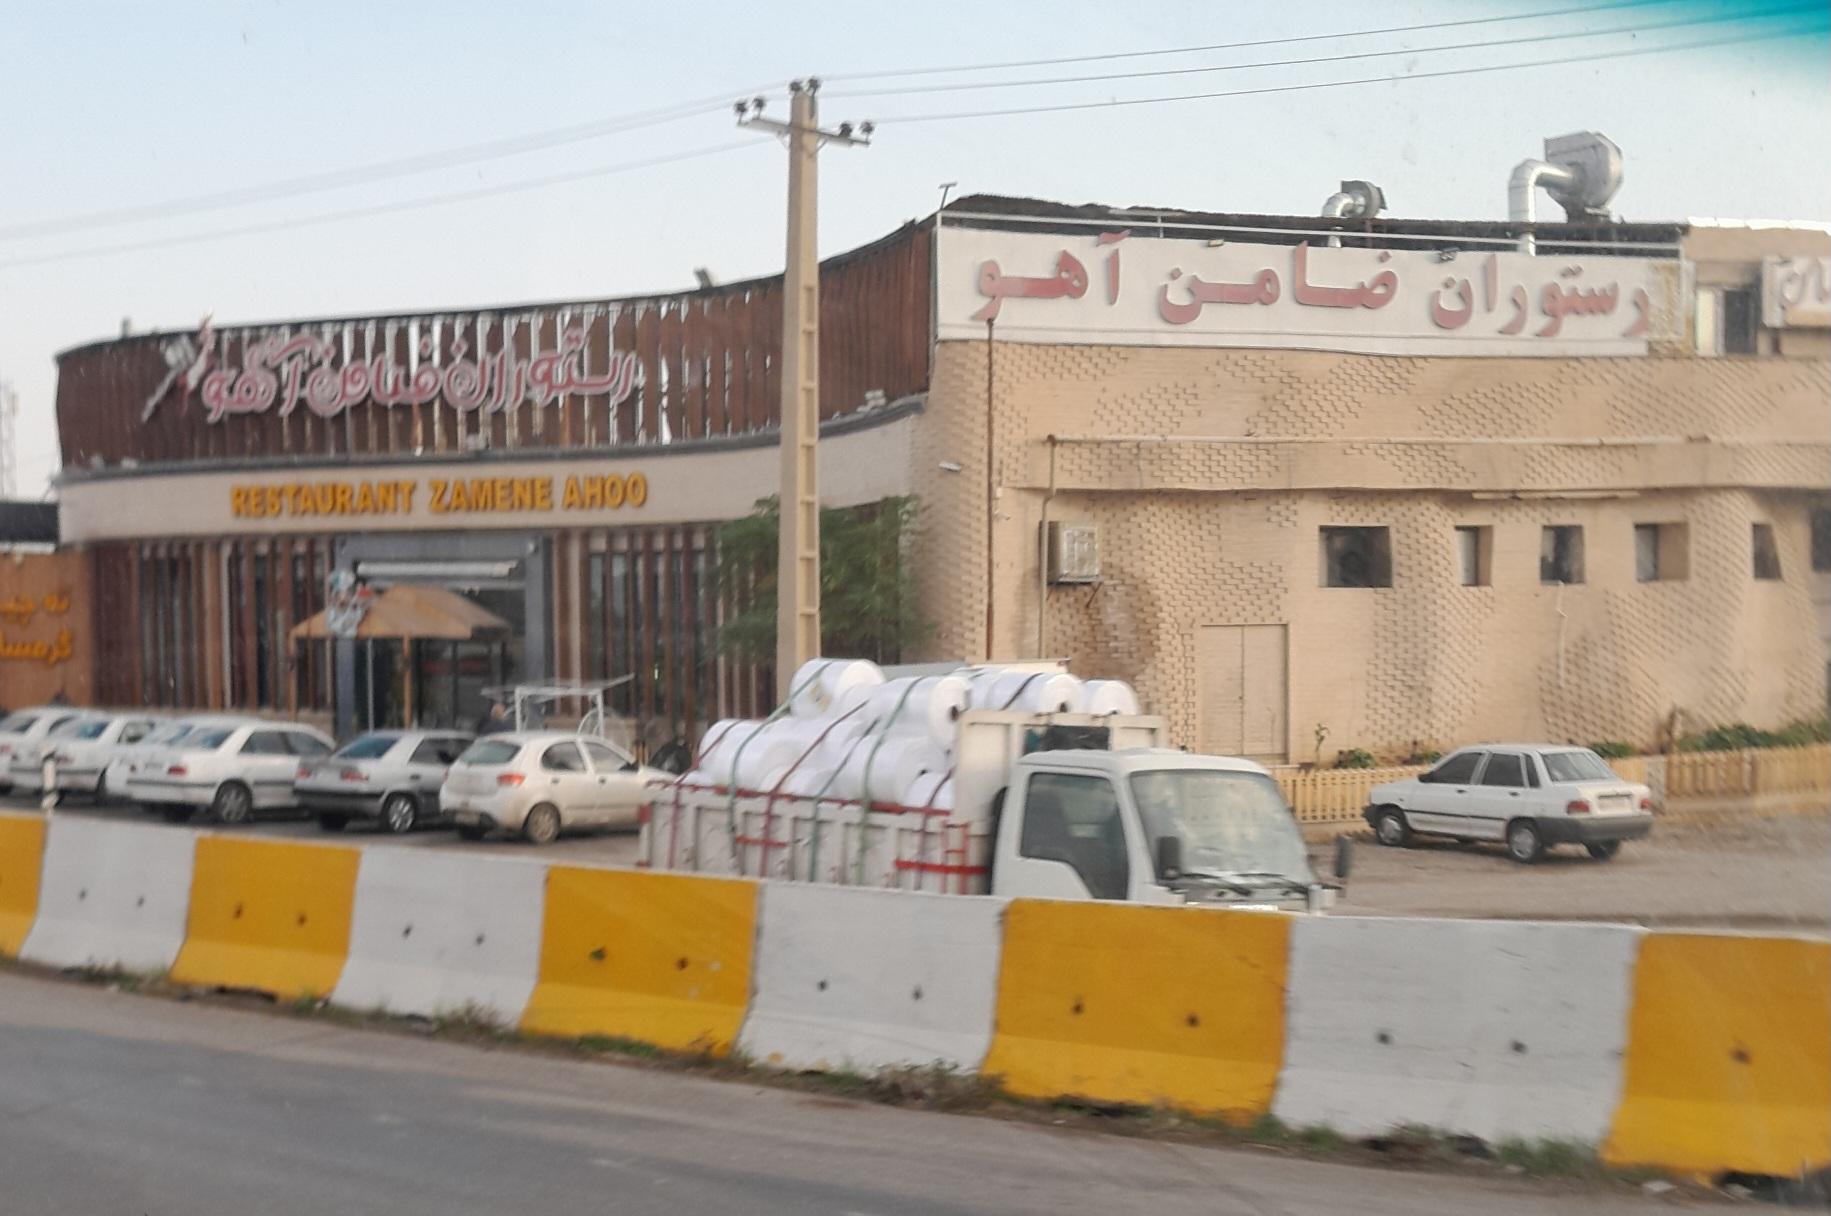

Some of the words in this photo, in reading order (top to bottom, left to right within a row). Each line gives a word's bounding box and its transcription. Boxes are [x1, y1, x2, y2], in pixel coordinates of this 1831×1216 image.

[971, 228, 1132, 322] آهو
[1159, 240, 1398, 325] ضامن
[1430, 253, 1650, 338] رستوران
[305, 332, 444, 418] ضامن
[442, 327, 638, 414] رستوران
[230, 480, 417, 518] RESTAURANT
[428, 476, 554, 515] ZAMENE
[562, 470, 649, 510] AHOO
